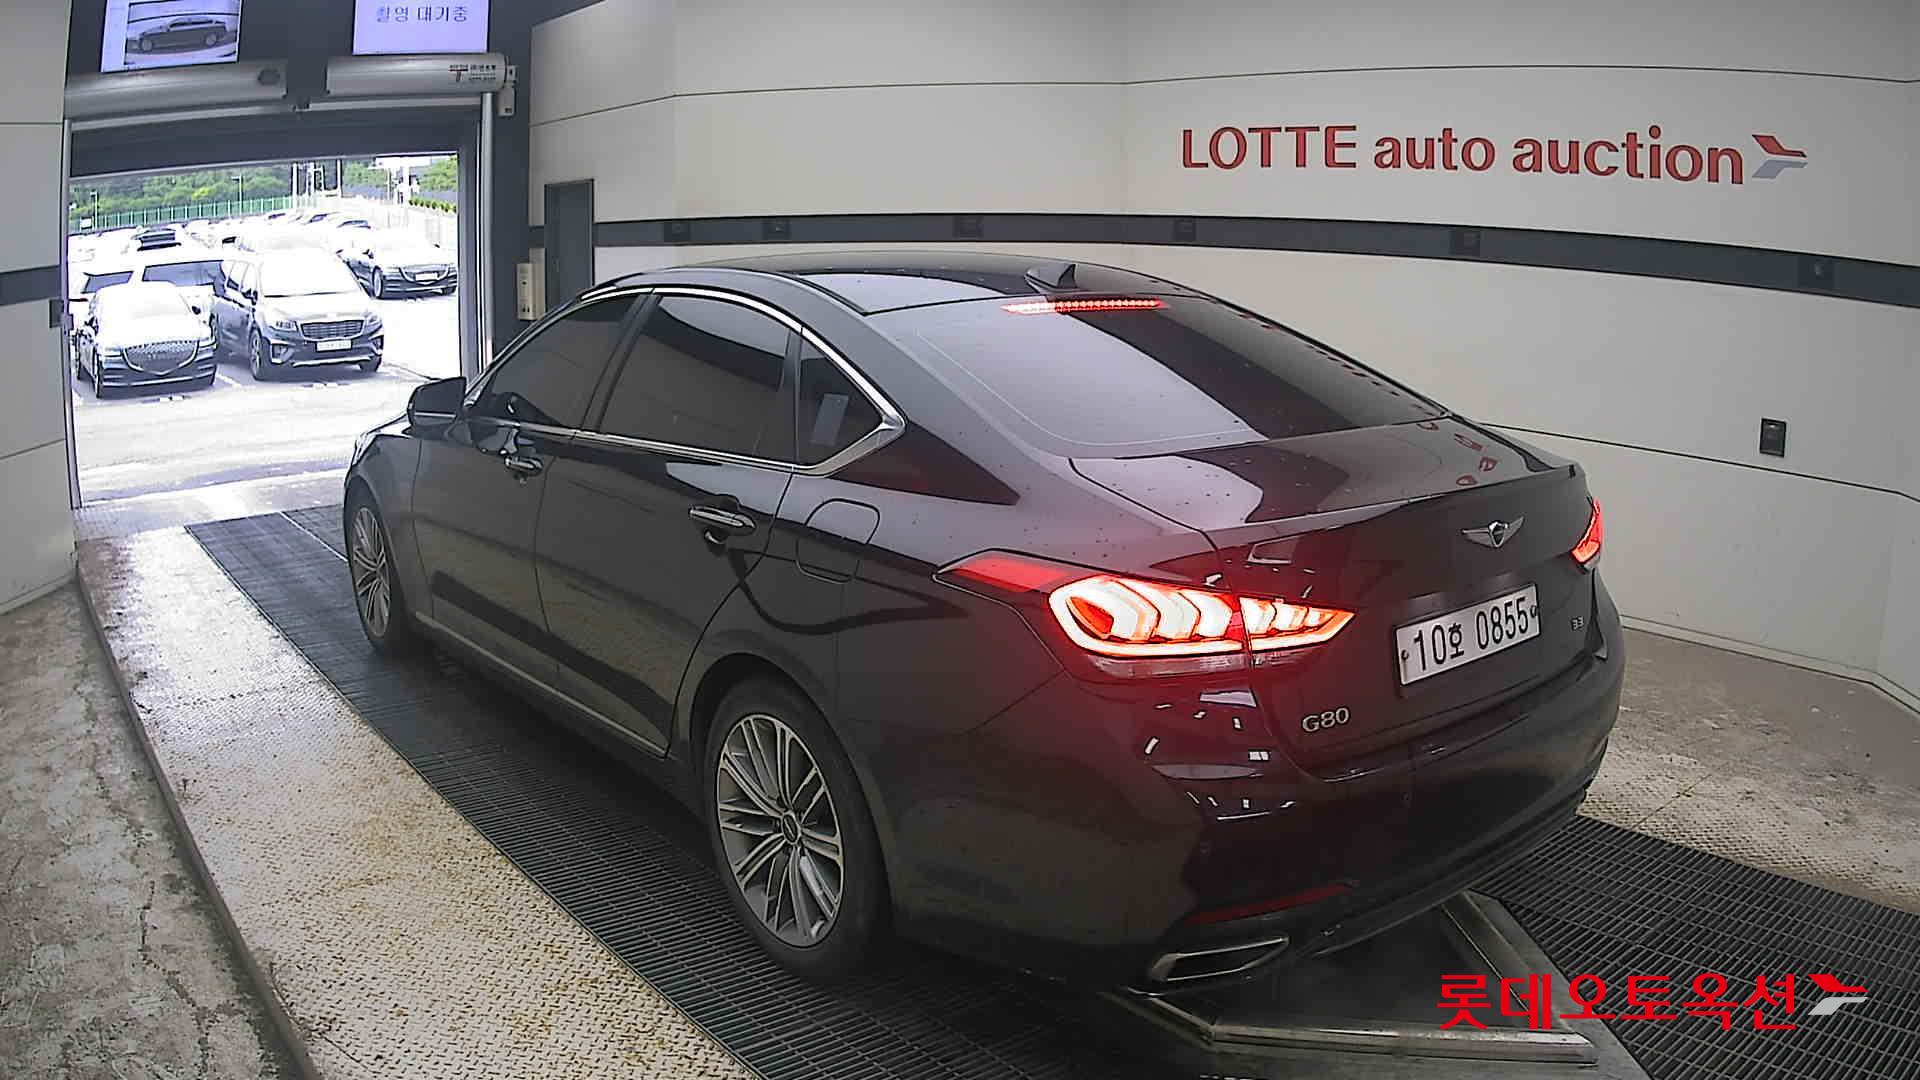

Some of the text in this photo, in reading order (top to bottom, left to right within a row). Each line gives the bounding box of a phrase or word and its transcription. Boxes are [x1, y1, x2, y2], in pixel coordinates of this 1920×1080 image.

[418, 5, 467, 22] 대기중
[1183, 125, 1743, 184] LOTTE auto auction
[1414, 597, 1529, 671] 10호 0855
[1302, 707, 1350, 732] G80
